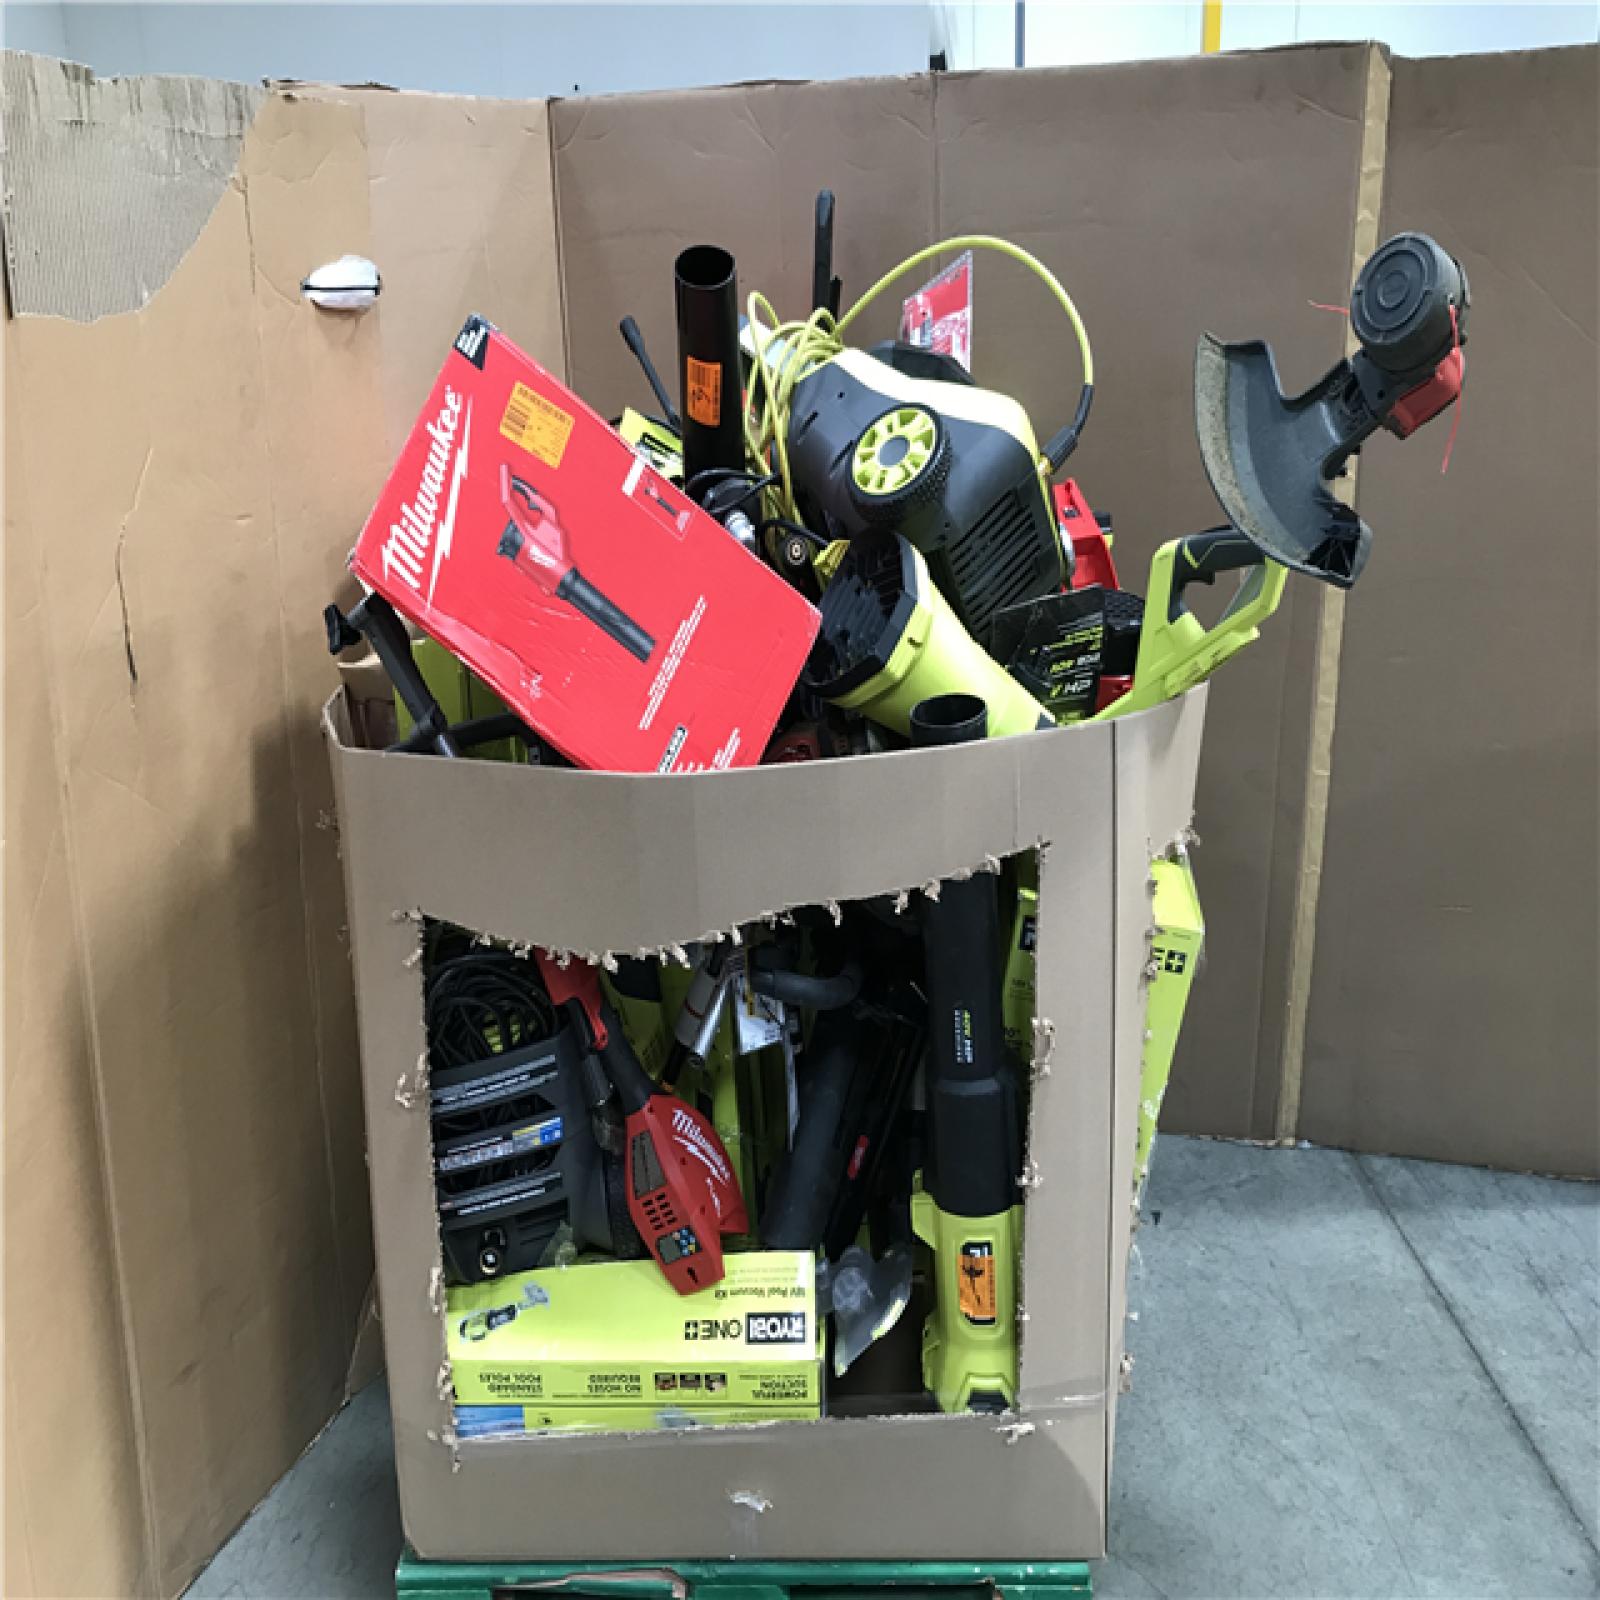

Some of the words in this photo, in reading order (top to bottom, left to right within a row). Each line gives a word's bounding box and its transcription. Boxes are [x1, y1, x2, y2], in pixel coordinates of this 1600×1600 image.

[380, 384, 463, 589] Milwaukee
[729, 1288, 766, 1298] Vacuum
[748, 1316, 804, 1339] RYOBI
[478, 1373, 511, 1382] POLES
[513, 1374, 541, 1383] POOL
[587, 1374, 641, 1383] REQUIRED
[487, 1384, 543, 1394] STANDARD
[586, 1384, 621, 1393] HOSES
[624, 1384, 642, 1393] NO
[759, 1379, 808, 1389] SUCTION
[751, 1390, 809, 1400] POWERFUL
